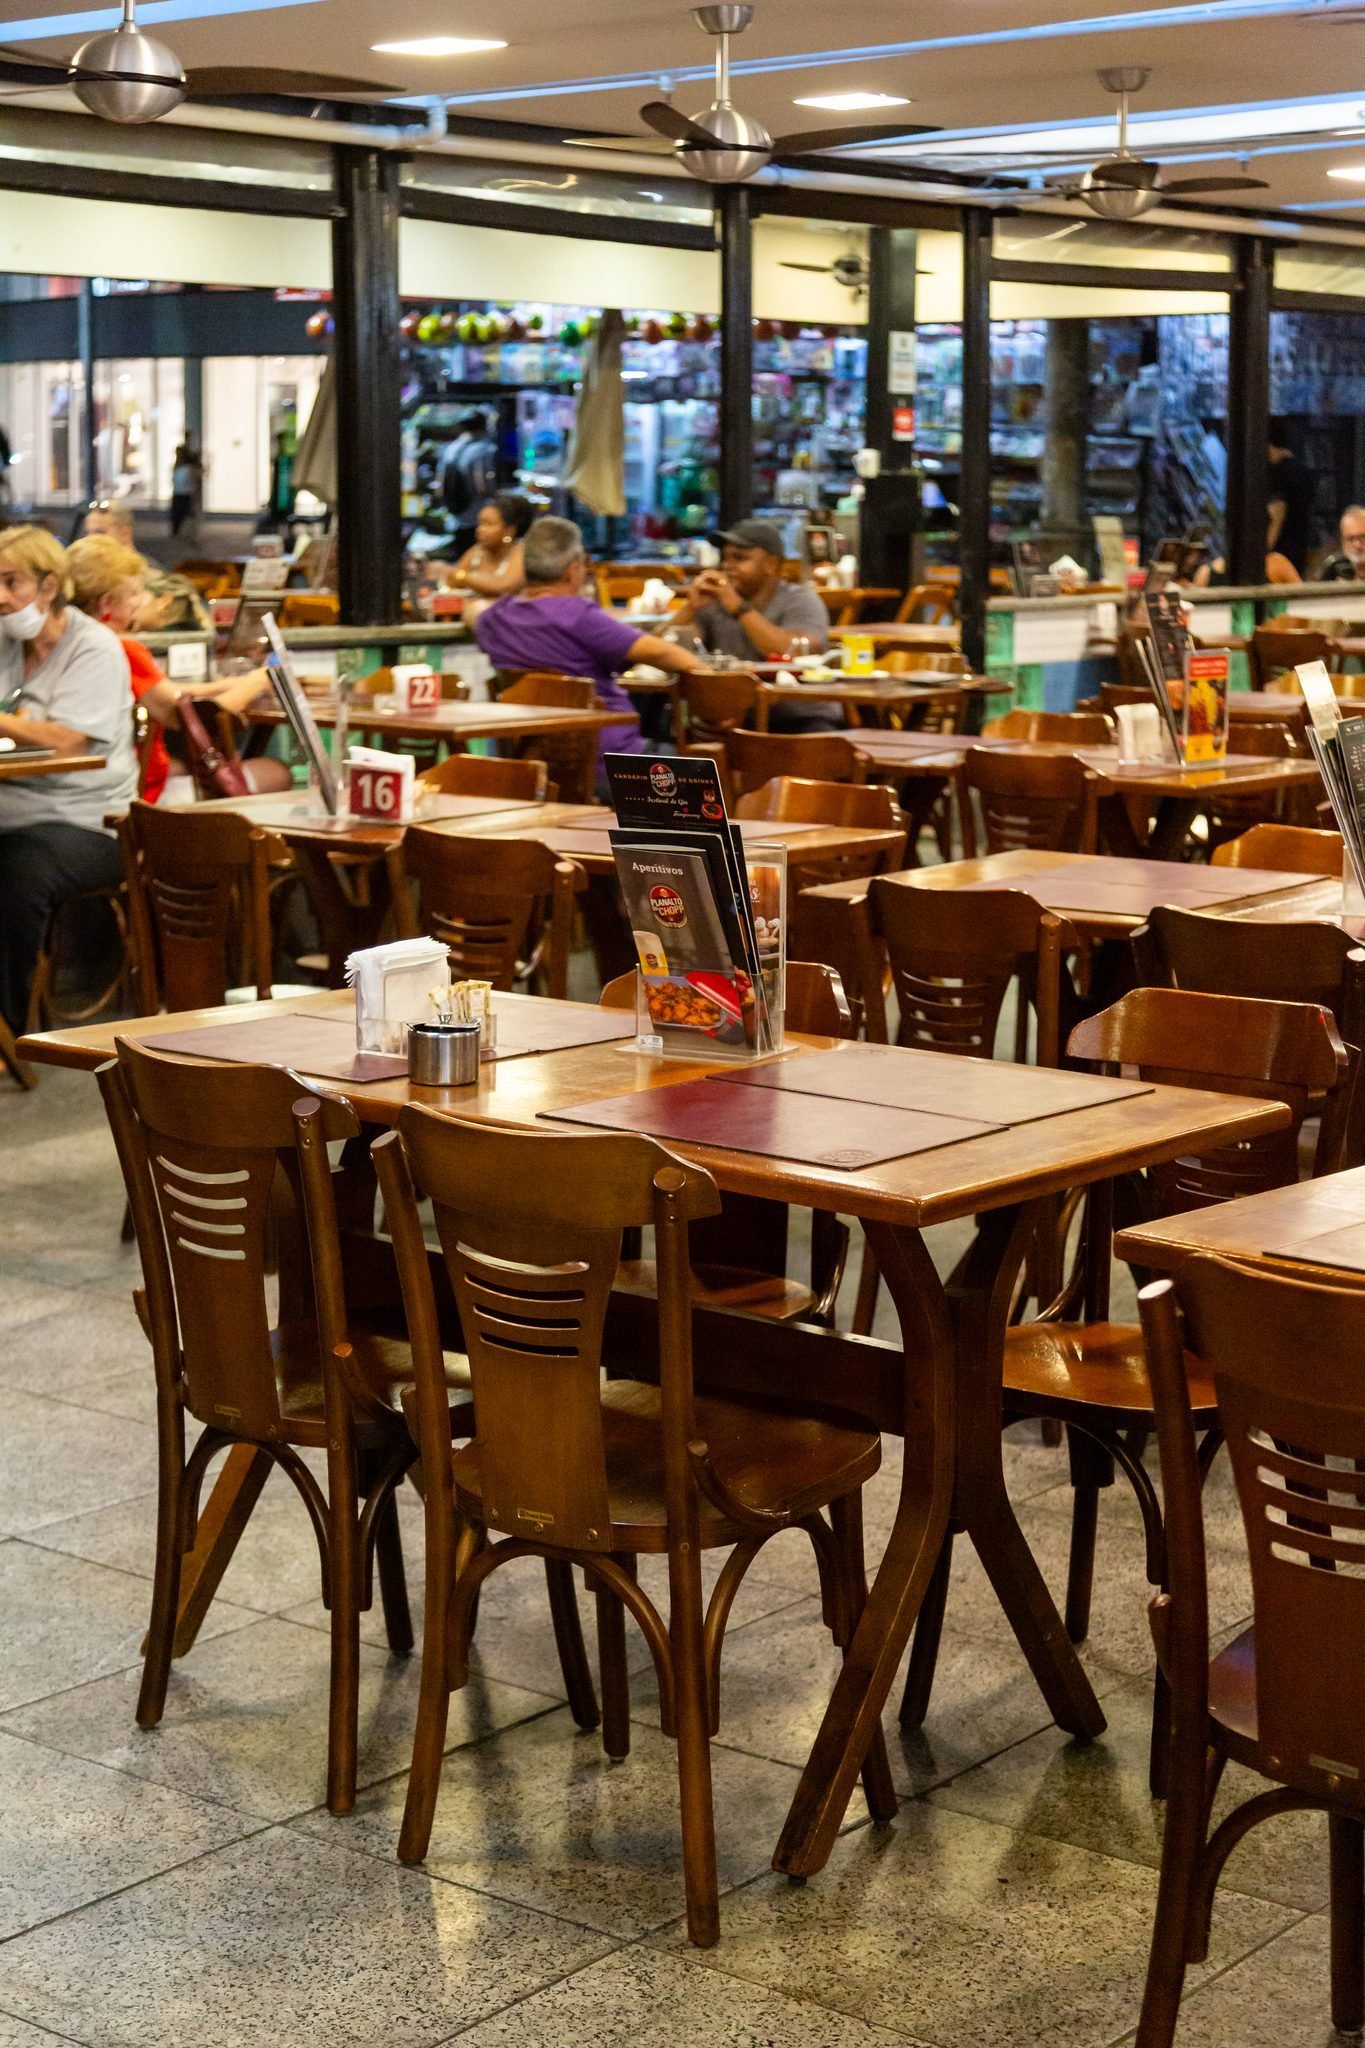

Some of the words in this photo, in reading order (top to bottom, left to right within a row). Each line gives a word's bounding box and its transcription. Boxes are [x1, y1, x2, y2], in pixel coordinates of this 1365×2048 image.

[411, 677, 435, 705] 22
[357, 773, 395, 812] 16
[632, 861, 684, 875] Aperitivos
[650, 897, 683, 907] PLANALTO
[658, 905, 684, 916] CHOPP
